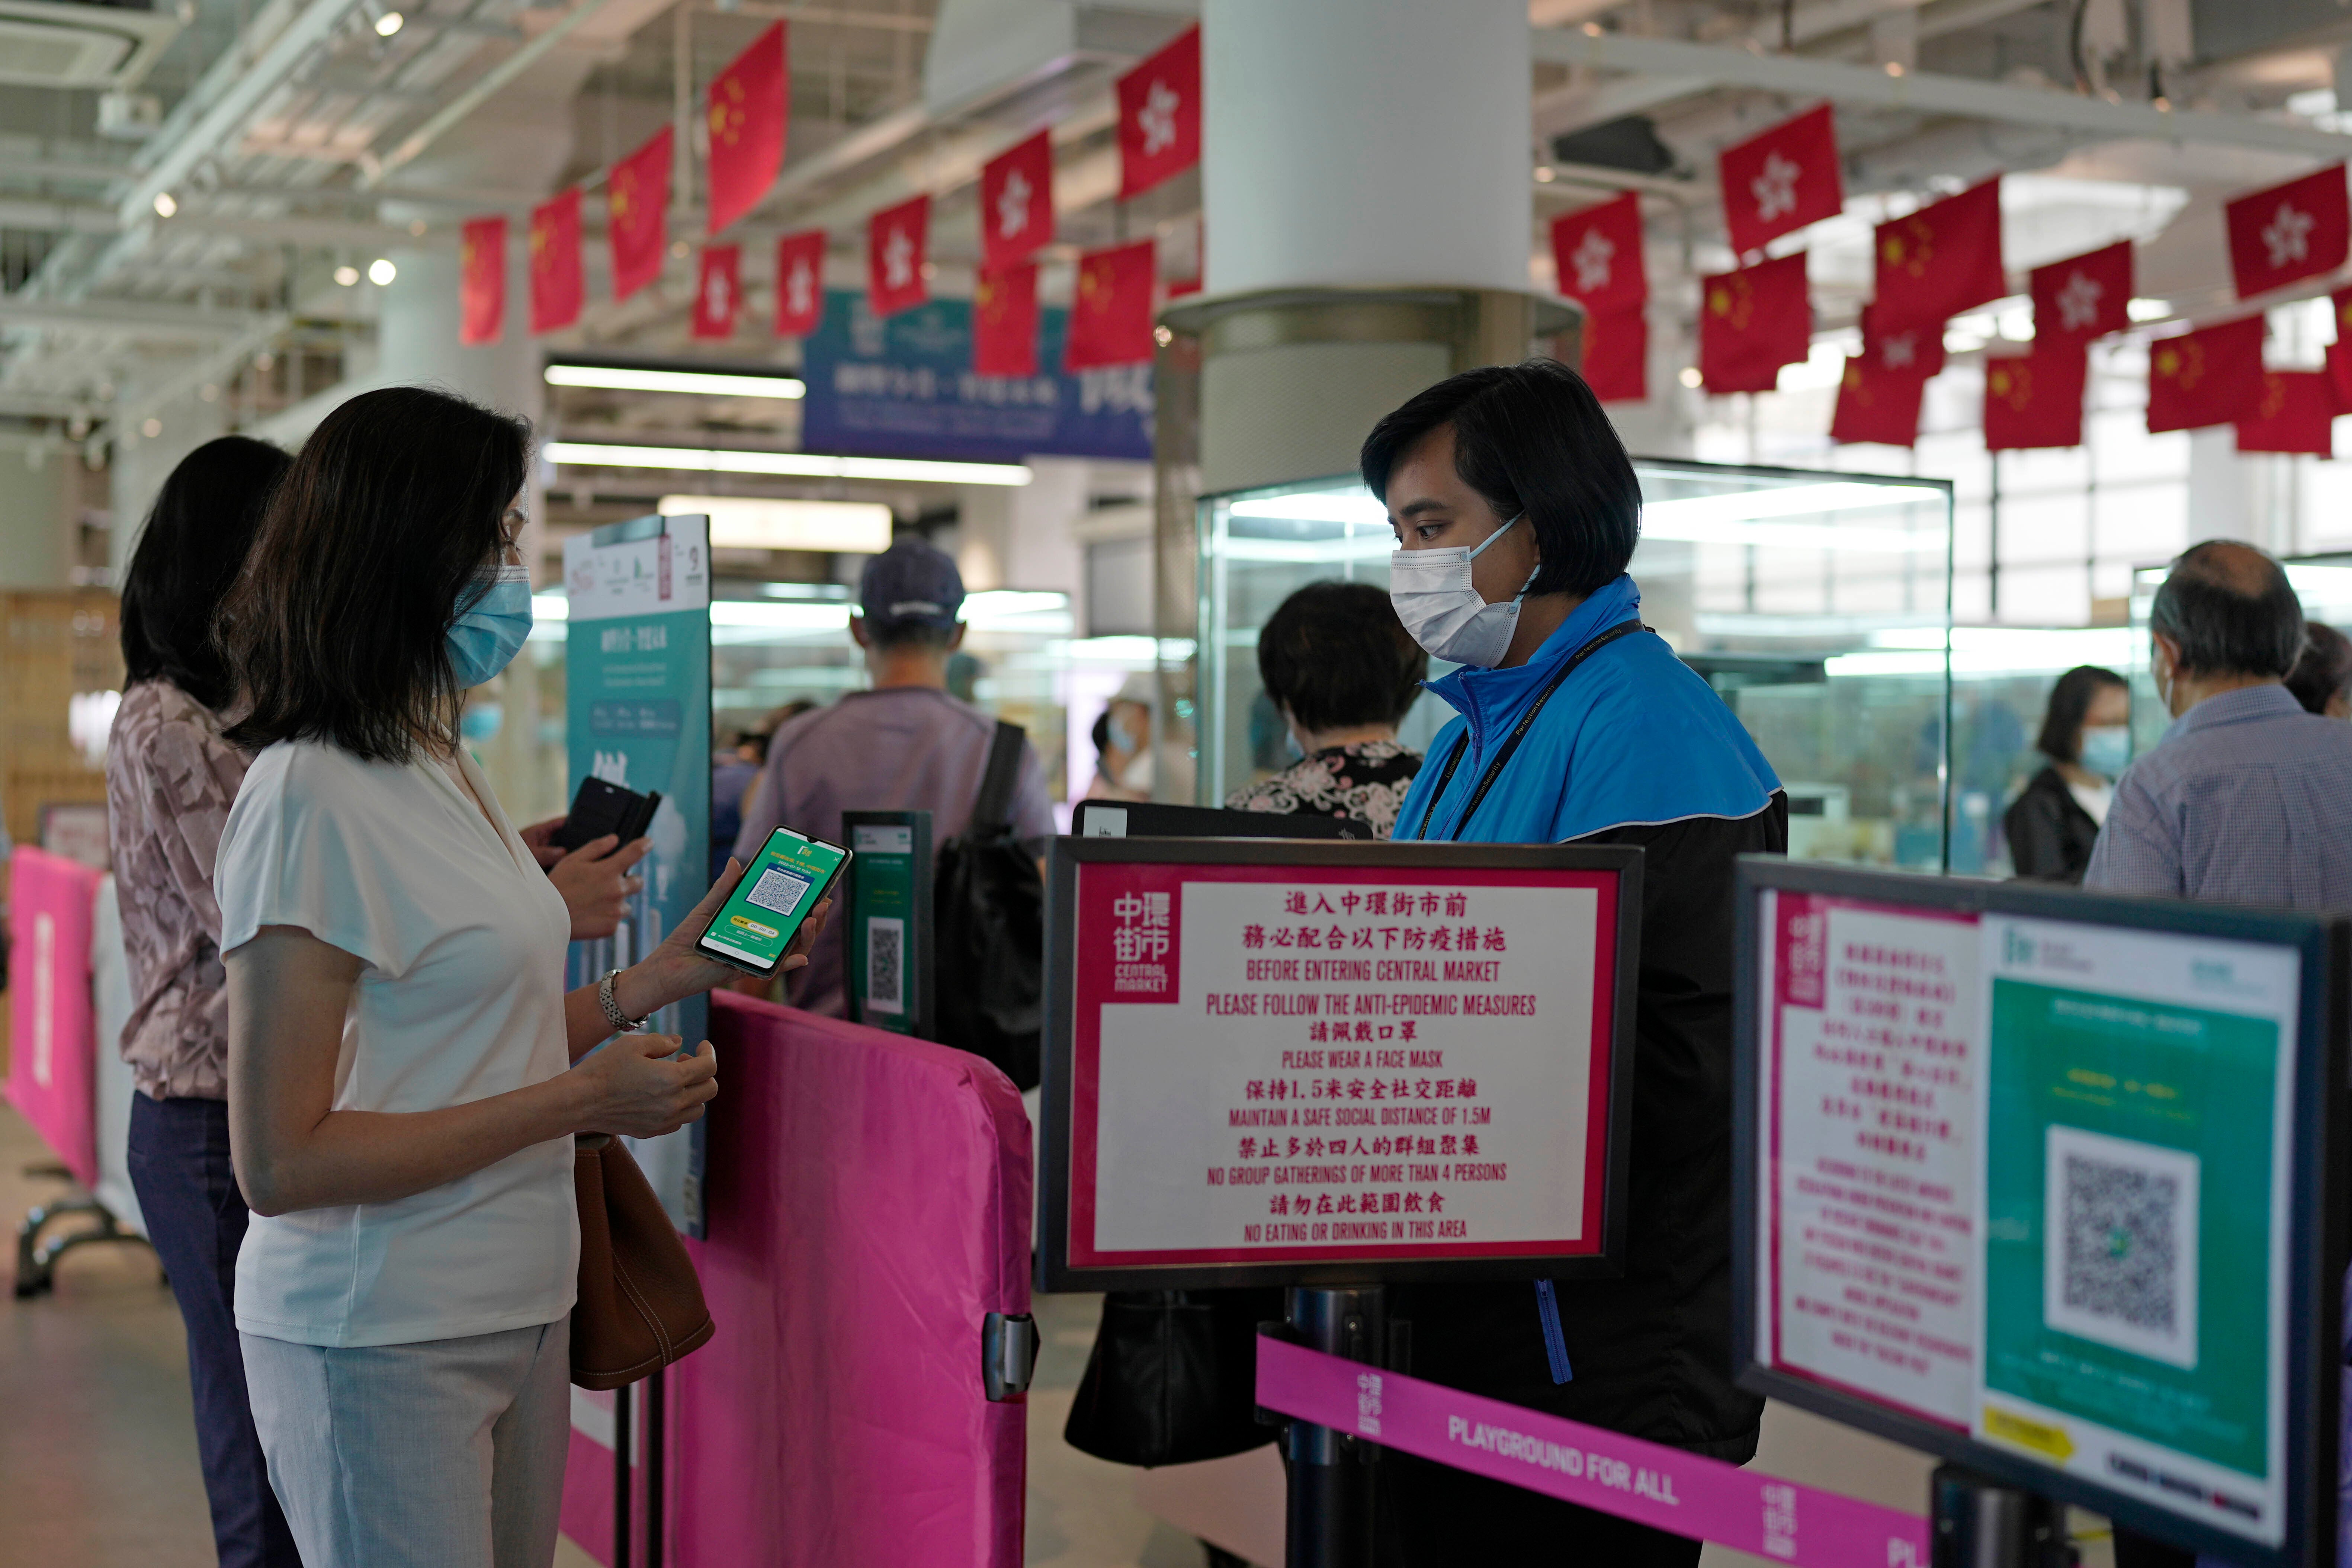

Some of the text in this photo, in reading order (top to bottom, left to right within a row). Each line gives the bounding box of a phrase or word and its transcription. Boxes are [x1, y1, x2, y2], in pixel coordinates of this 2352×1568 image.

[1515, 684, 1554, 735] PerfectionSecurity
[1285, 890, 1468, 918] 進入中環街市前
[1243, 924, 1507, 952] 務必配合以下防疫措施
[1247, 959, 1501, 982] BEFORE ENTERING CENTRAL MARKET
[1207, 993, 1536, 1016] PLEASE FOLLOW THE ANTI-EPIDEMIC MEASURES
[1310, 1020, 1417, 1043] 請佩戴口罩
[1282, 1050, 1443, 1069] PLEASE WEAR A FACE MASK
[1245, 1077, 1477, 1101] 保持1.5米安全社交距離
[1229, 1106, 1491, 1127] MAINTAIN A SAFE SOCIAL DISTANCE OF 1.5M
[1239, 1133, 1480, 1159] 禁止多於四人的群組聚集
[1207, 1163, 1507, 1185] NO GROUP GATHERINGS OF MORE THAN 4 PERSONS
[1270, 1191, 1445, 1216] 請勿在此範圍飲食
[1245, 1219, 1467, 1242] NO EATING OR DRINKING IN THIS AREA
[1448, 1414, 1679, 1506] PLAYGROUND FOR ALL
